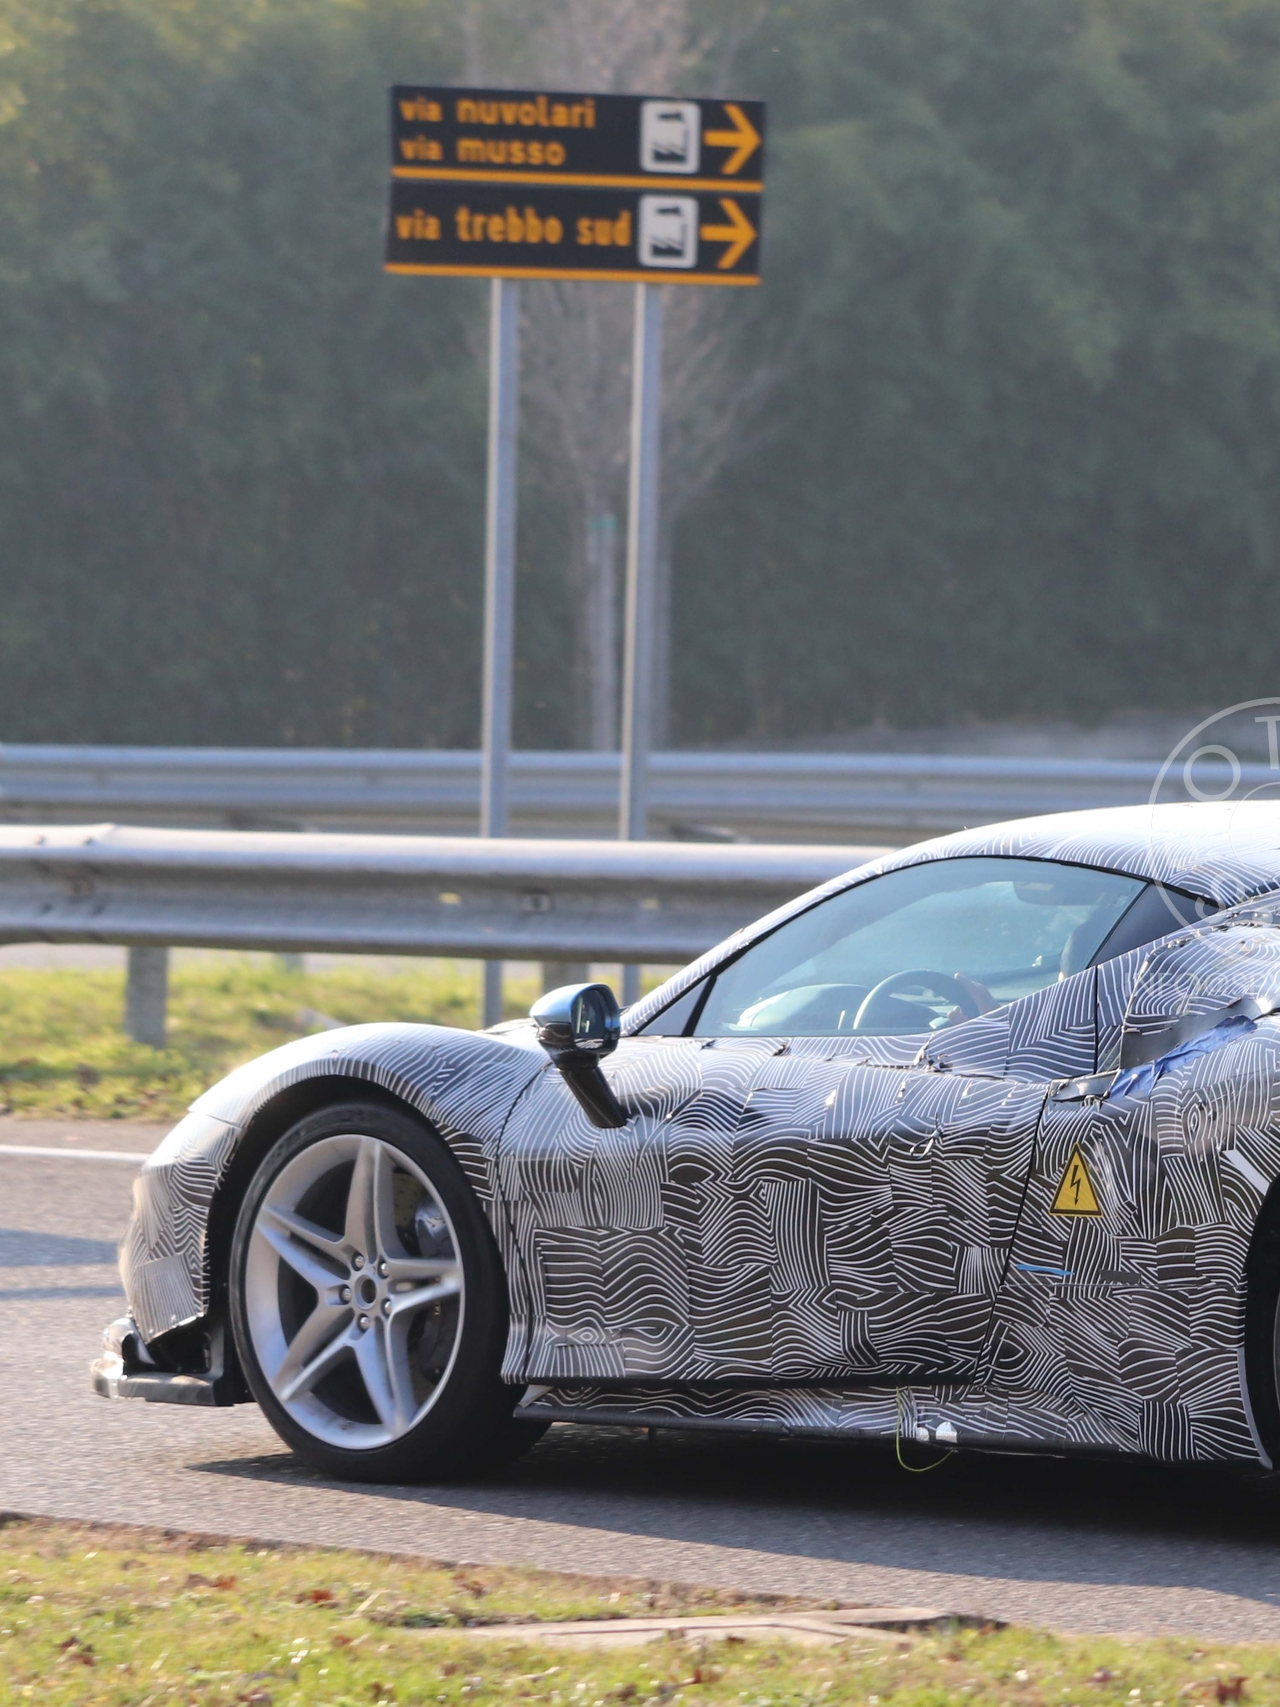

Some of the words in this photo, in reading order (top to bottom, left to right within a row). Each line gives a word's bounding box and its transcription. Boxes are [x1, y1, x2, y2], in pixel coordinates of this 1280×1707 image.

[400, 98, 443, 123] via
[456, 96, 596, 128] nuvolari
[400, 135, 443, 161] via
[456, 137, 566, 166] musso
[395, 208, 441, 241] via
[454, 206, 564, 246] trebbo
[576, 210, 632, 247] sud
